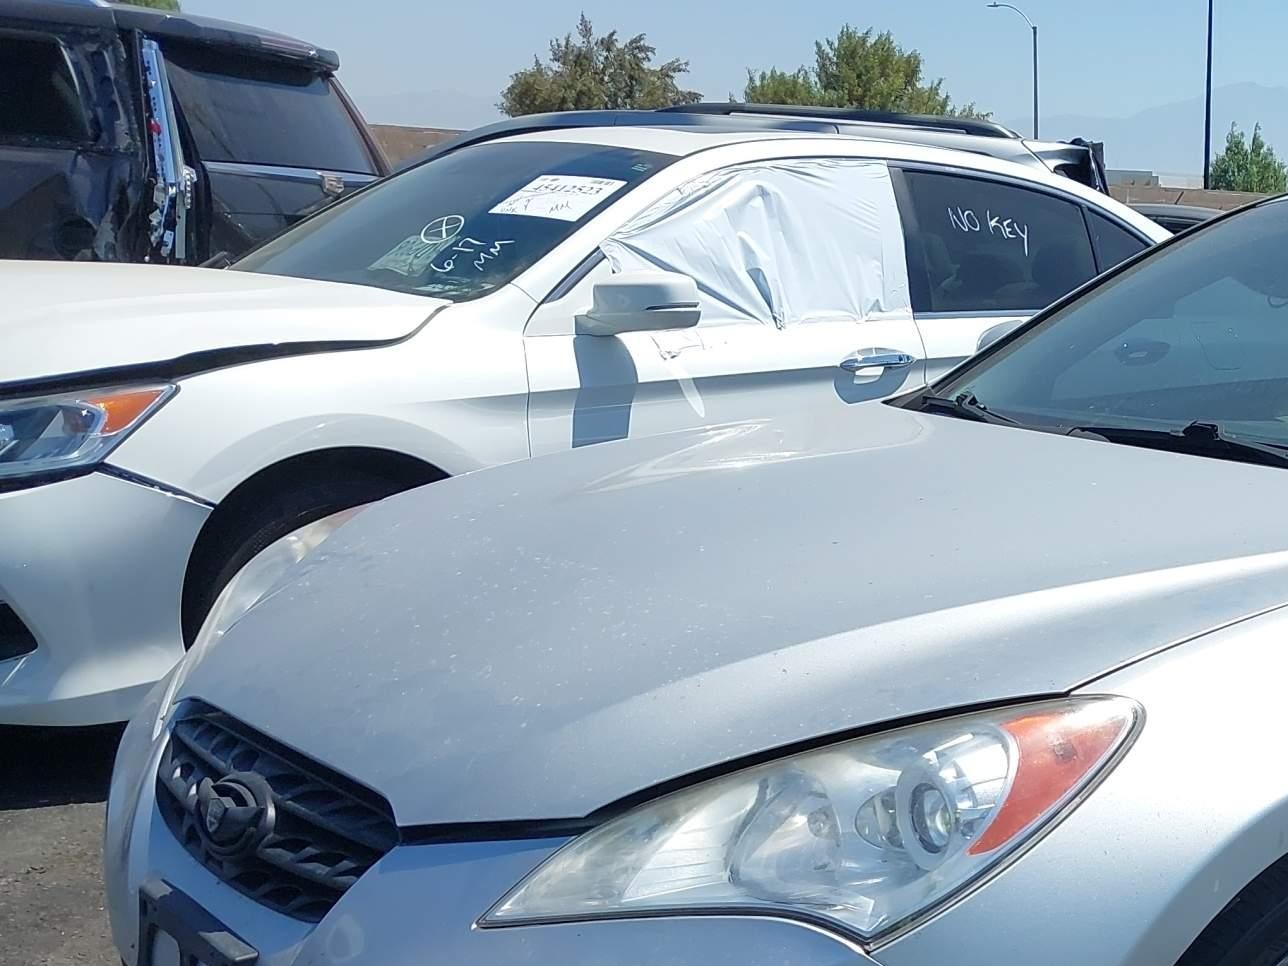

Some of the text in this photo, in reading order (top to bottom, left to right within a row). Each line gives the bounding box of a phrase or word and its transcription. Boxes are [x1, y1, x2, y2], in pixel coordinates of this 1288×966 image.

[947, 206, 1029, 257] NO KEY
[430, 237, 488, 273] 6-17
